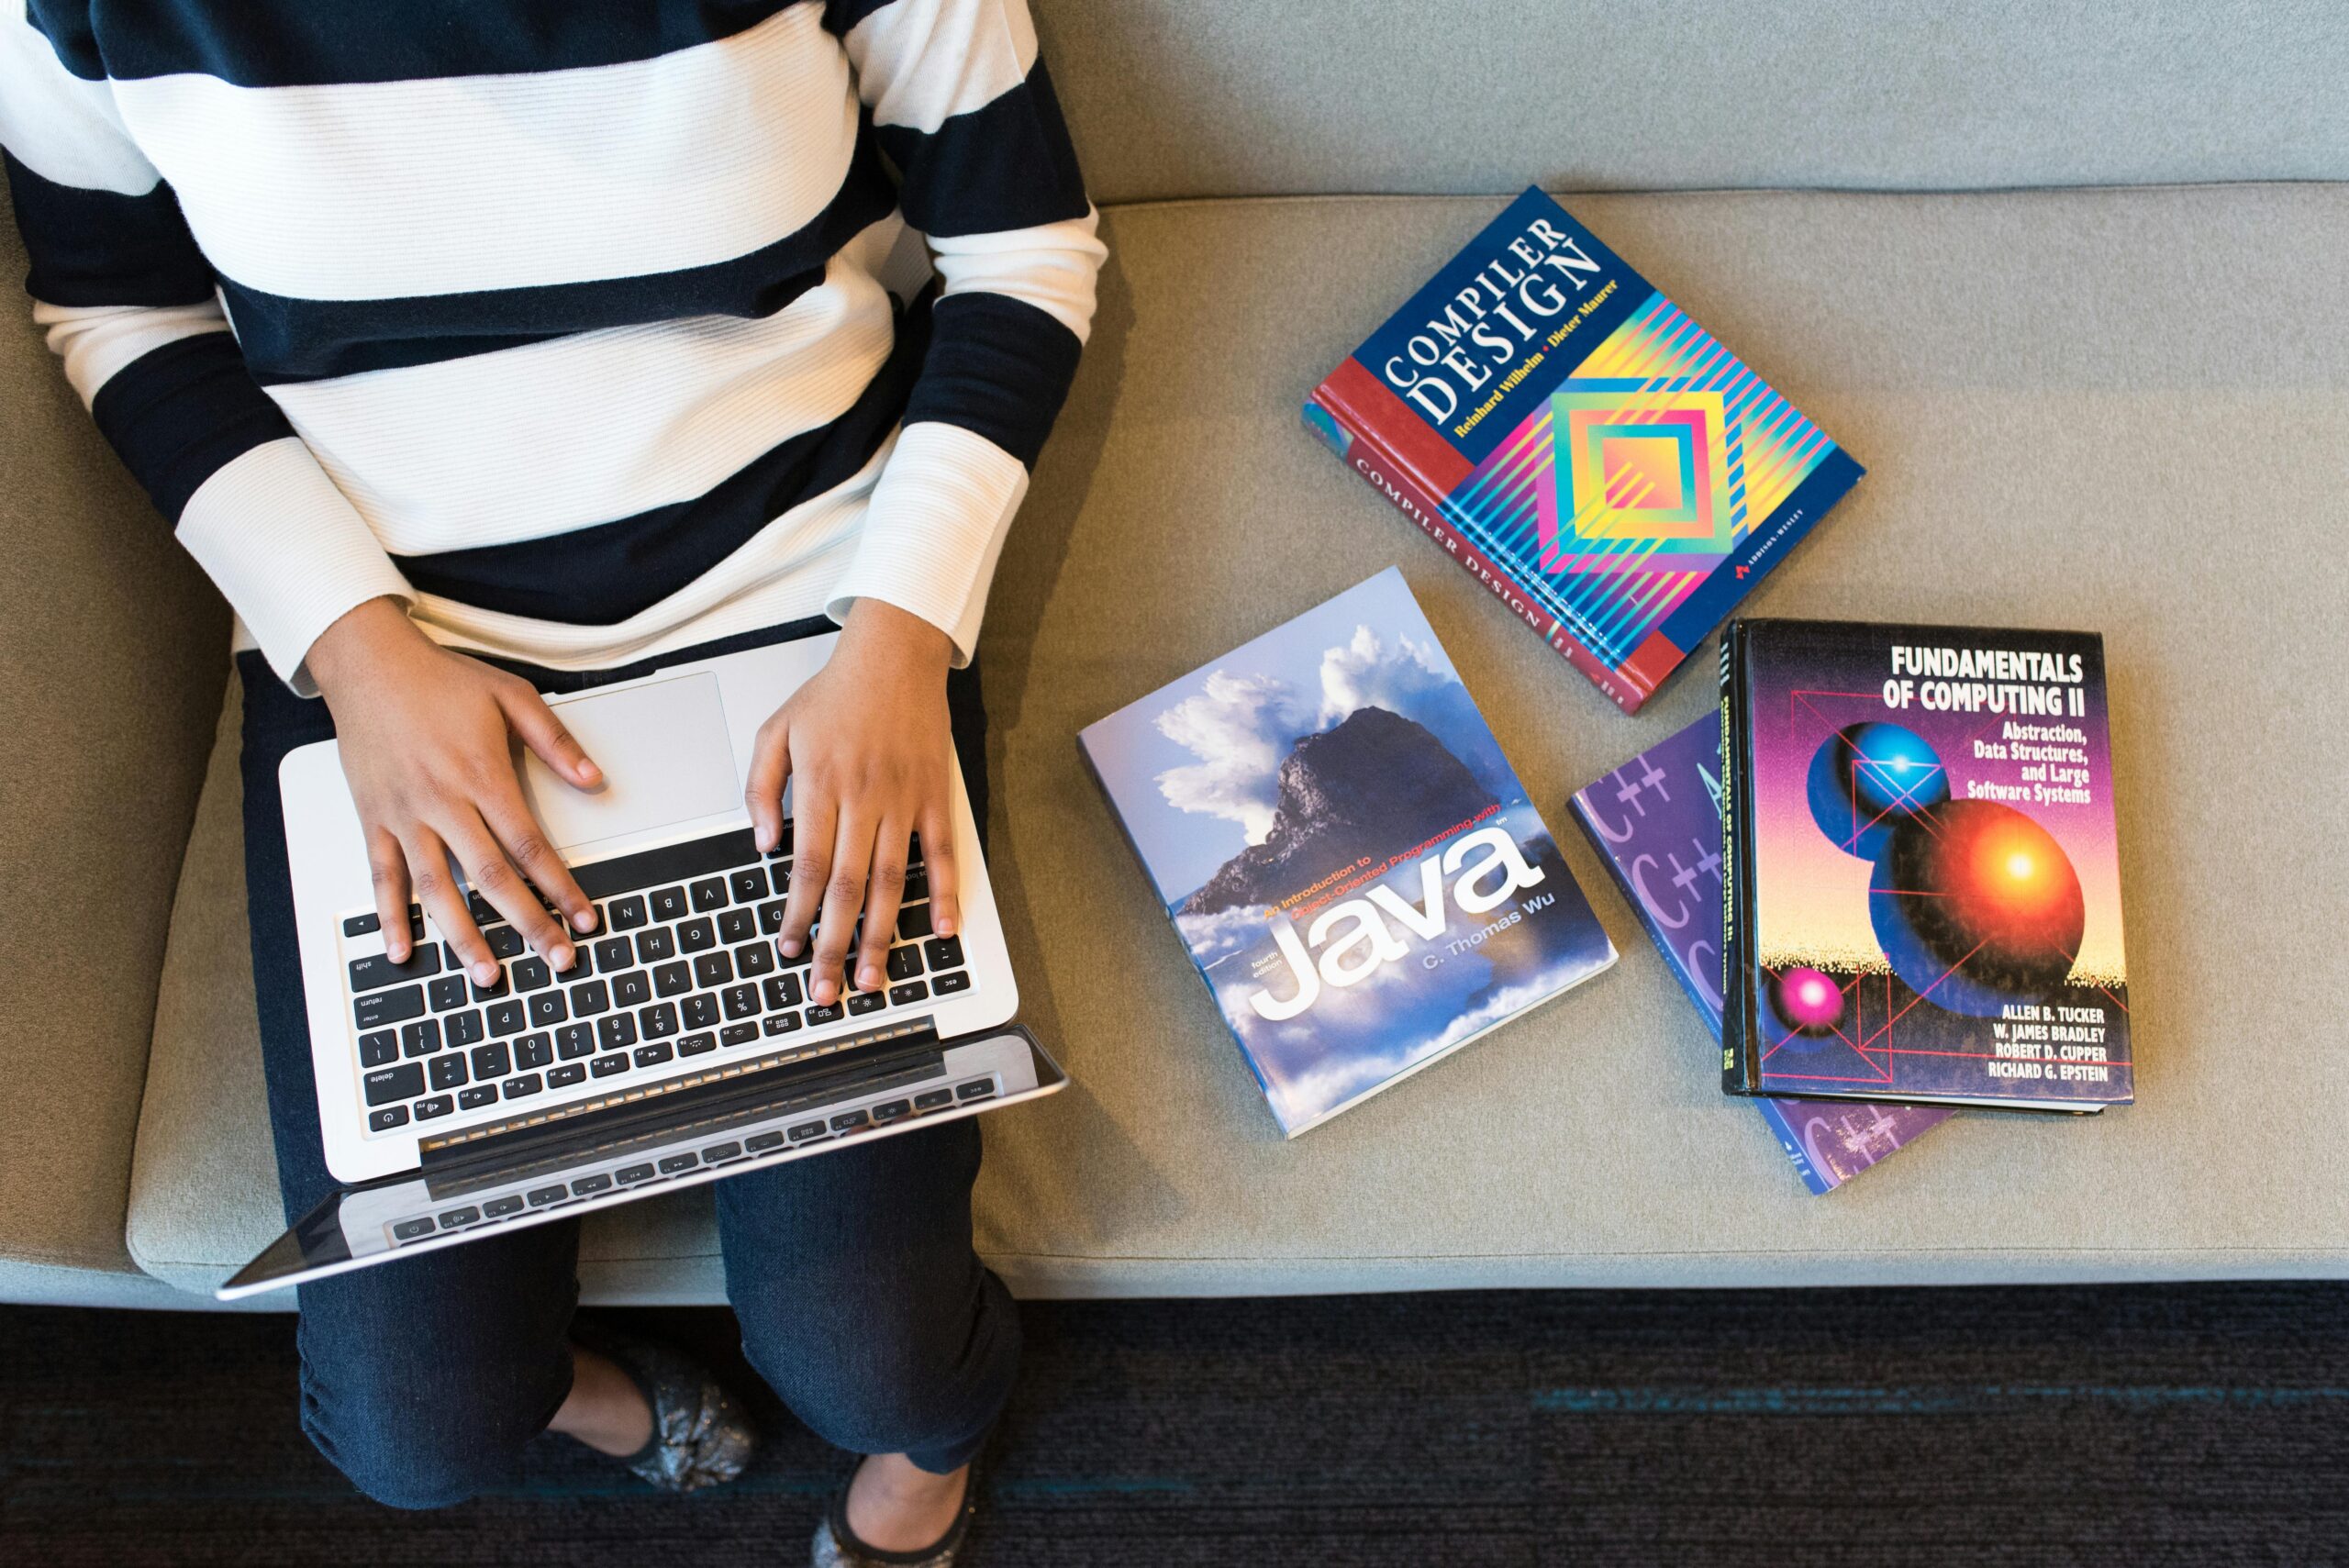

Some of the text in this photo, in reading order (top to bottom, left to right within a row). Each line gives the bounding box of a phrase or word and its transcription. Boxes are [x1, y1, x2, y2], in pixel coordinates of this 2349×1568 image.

[1385, 218, 1566, 388] COMPILER
[1406, 238, 1601, 426] DESIGN
[1453, 279, 1619, 439] Reinhard Wilhelm Dieter Maurer
[1356, 458, 1541, 627] COMPILER DESIGN
[1891, 646, 2084, 683] FUNDAMENTALS
[1883, 679, 2086, 717] OF COMPUTING II
[2002, 721, 2087, 745] Abstraction,
[1723, 695, 1731, 811] FUNDAMENTALS
[1974, 740, 2088, 765] Data Structures,
[2021, 763, 2090, 788] and Large
[1967, 780, 2091, 806] Software Systems
[1726, 813, 1732, 832] OF
[1291, 804, 1501, 921] Object-Oriented Programming with
[744, 880, 754, 889] C
[1264, 855, 1372, 919] An Introduction to
[1631, 838, 1722, 929] C++
[706, 889, 714, 899] V
[665, 898, 673, 908] B
[623, 907, 632, 917] N
[773, 911, 781, 920] D
[734, 920, 740, 930] F
[1249, 827, 1546, 1021] Java
[691, 929, 700, 940] G
[1422, 893, 1555, 970] C. Thomas Wu
[651, 940, 660, 950] H
[611, 949, 617, 959] J
[751, 954, 758, 963] R
[1252, 951, 1278, 969] fourth
[356, 962, 372, 971] shift
[710, 965, 718, 974] T
[1252, 960, 1282, 978] edition
[527, 968, 535, 977] L
[669, 973, 676, 984] Y
[627, 983, 636, 994] U
[777, 981, 785, 990] 4
[737, 990, 742, 1000] 5
[361, 997, 383, 1006] return
[695, 1000, 702, 1009] 6
[363, 1014, 379, 1022] enter
[502, 1013, 509, 1022] P
[654, 1009, 662, 1019] 7
[2002, 1004, 2105, 1024] ALLEN B. TUCKER
[612, 1019, 619, 1029] 8
[571, 1029, 578, 1039] 9
[1993, 1023, 2106, 1043] W. JAMES BRADLEY
[1996, 1042, 2108, 1062] ROBERT D. CUPPER
[1988, 1062, 2109, 1082] RICHARD G. EPSTEIN
[371, 1073, 394, 1083] delete
